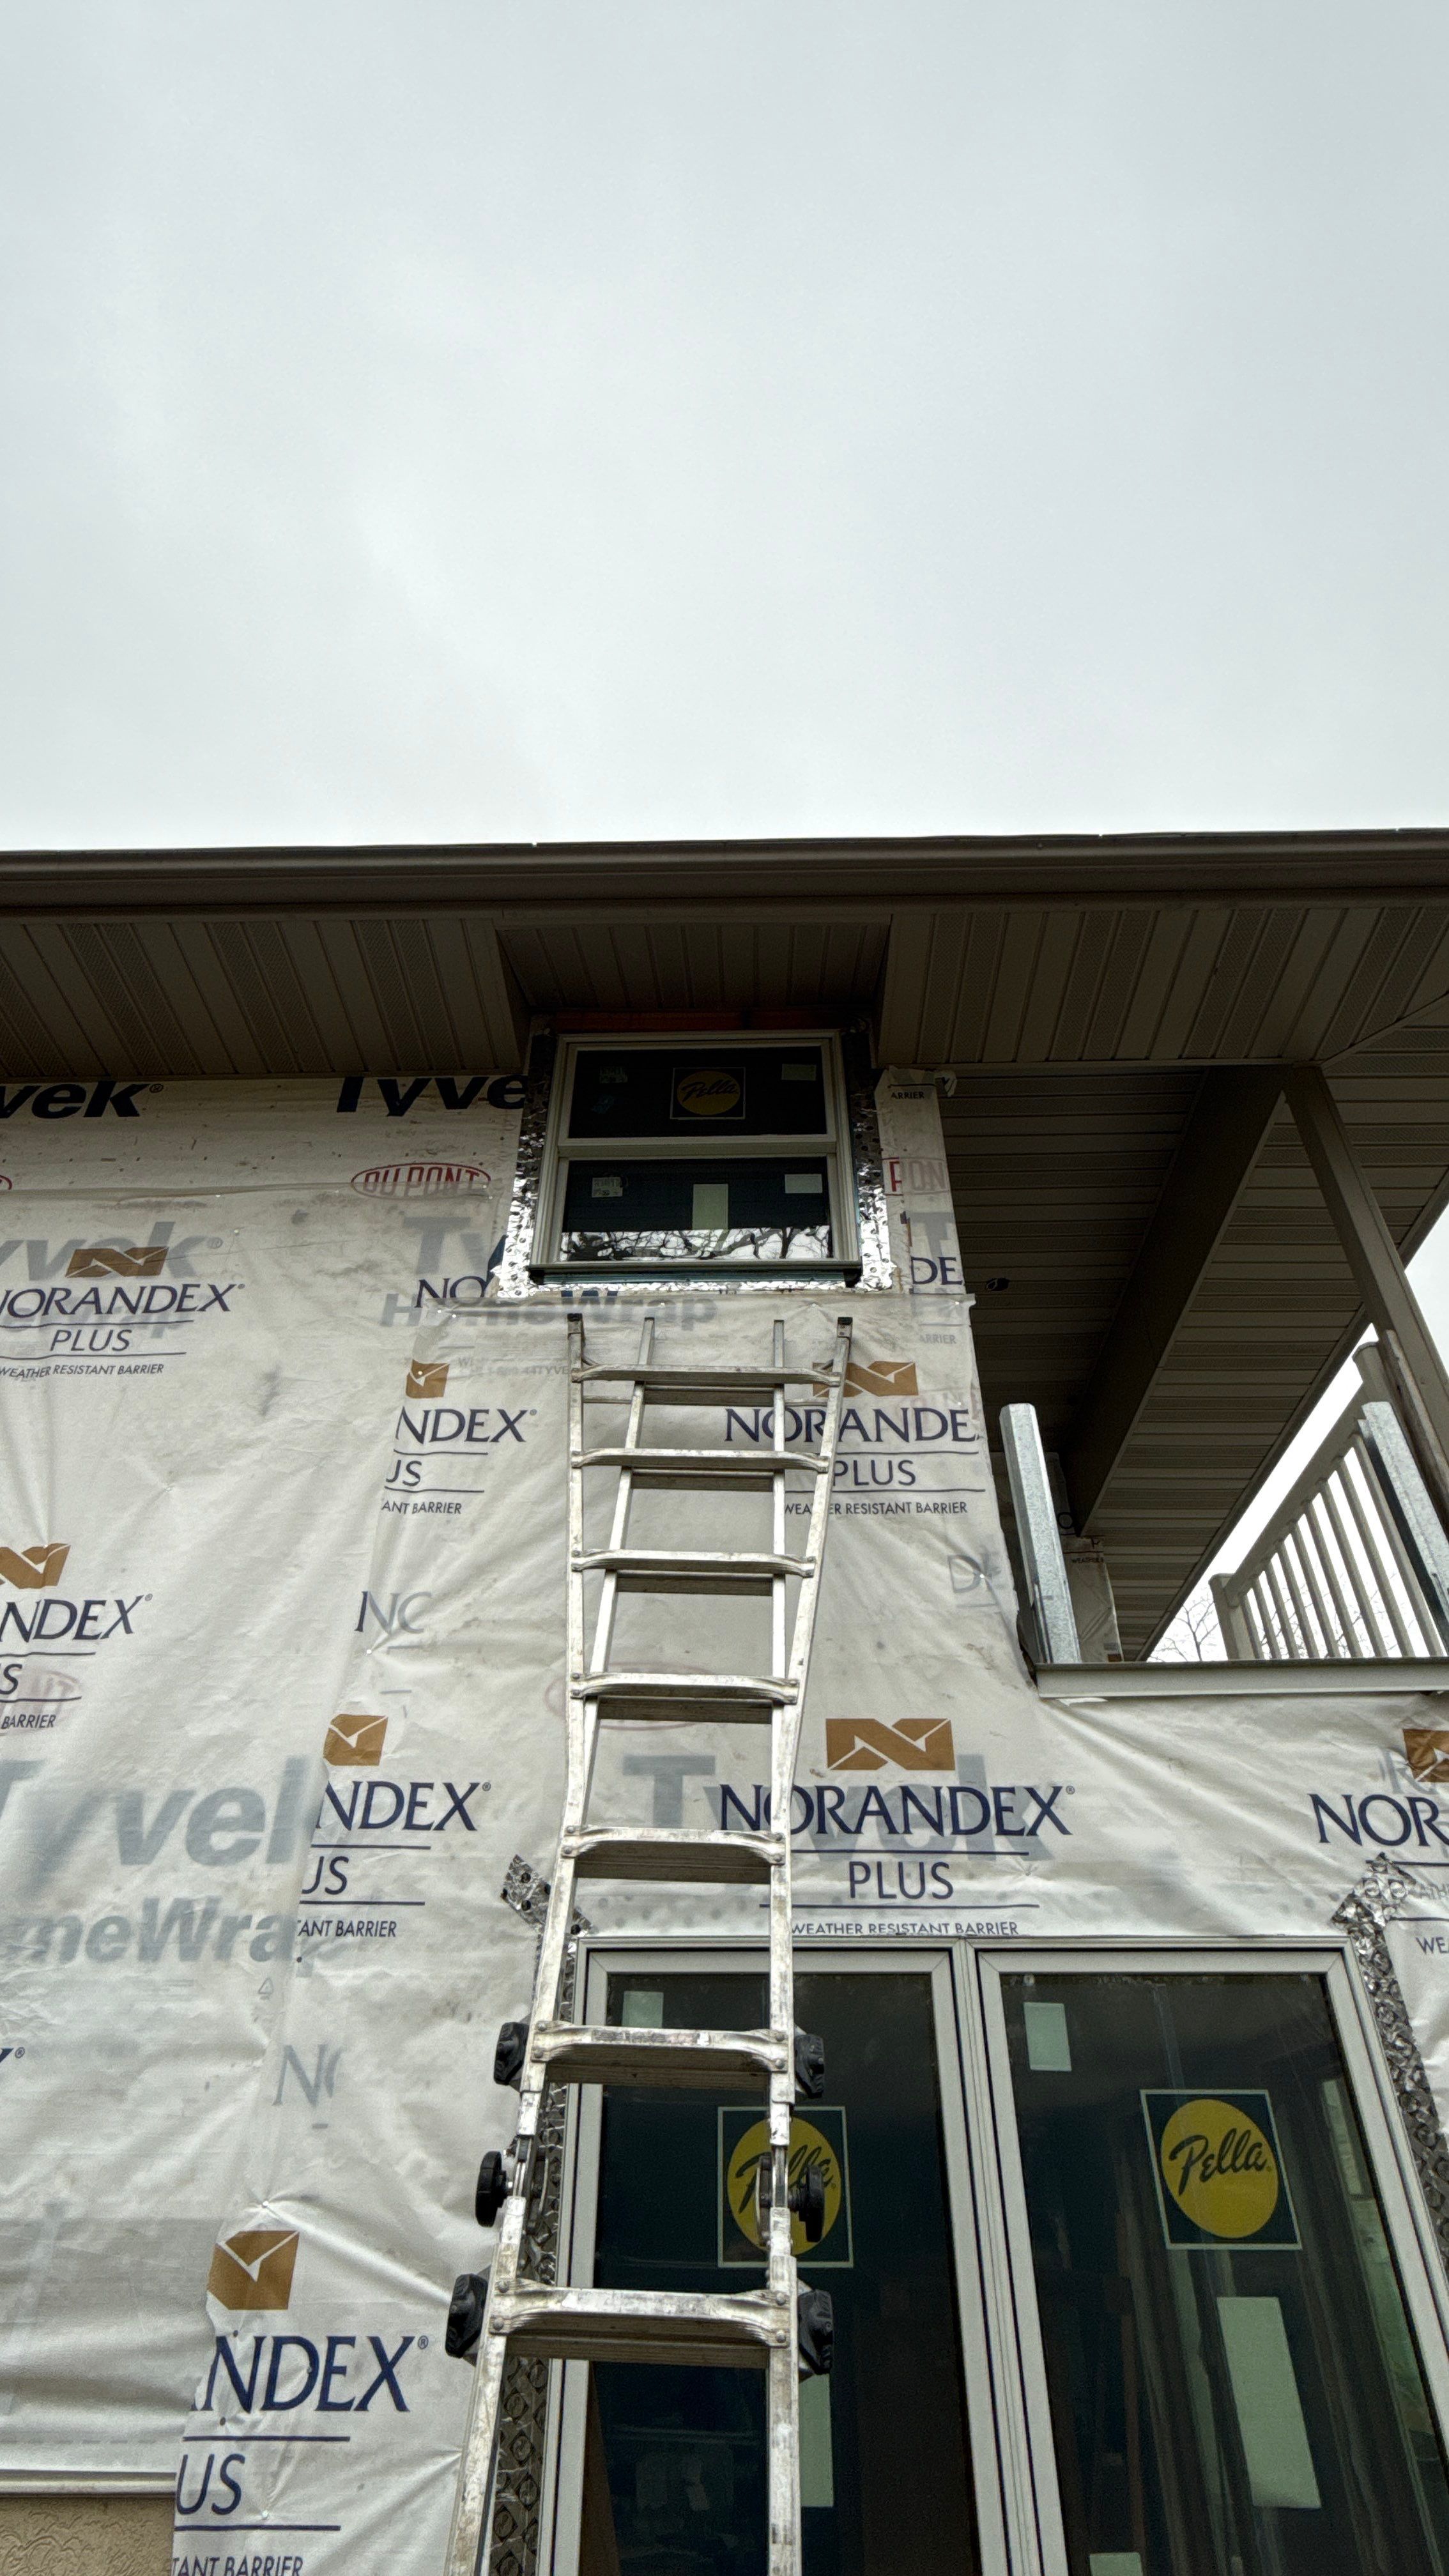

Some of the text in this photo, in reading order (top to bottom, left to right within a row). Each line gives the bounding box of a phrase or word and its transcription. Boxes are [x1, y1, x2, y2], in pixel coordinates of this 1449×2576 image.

[681, 1078, 739, 1103] Pella
[50, 1330, 132, 1352] PLUS
[52, 1365, 116, 1375] RESISTANT
[118, 1364, 164, 1375] BARRIER
[832, 1459, 916, 1486] PLUS
[411, 1501, 463, 1515] BARRIER
[785, 1501, 968, 1515] WEAER RESISTANT BARRIER
[1, 1714, 56, 1729] BARRIER
[1308, 1793, 1449, 1846] NOR
[849, 1861, 953, 1900] PLUS
[335, 1920, 397, 1937] BARRIER
[792, 1921, 1018, 1935] WEATHER RESISTANT BARRIER
[1169, 2128, 1268, 2196] Pella
[176, 2453, 246, 2515] US
